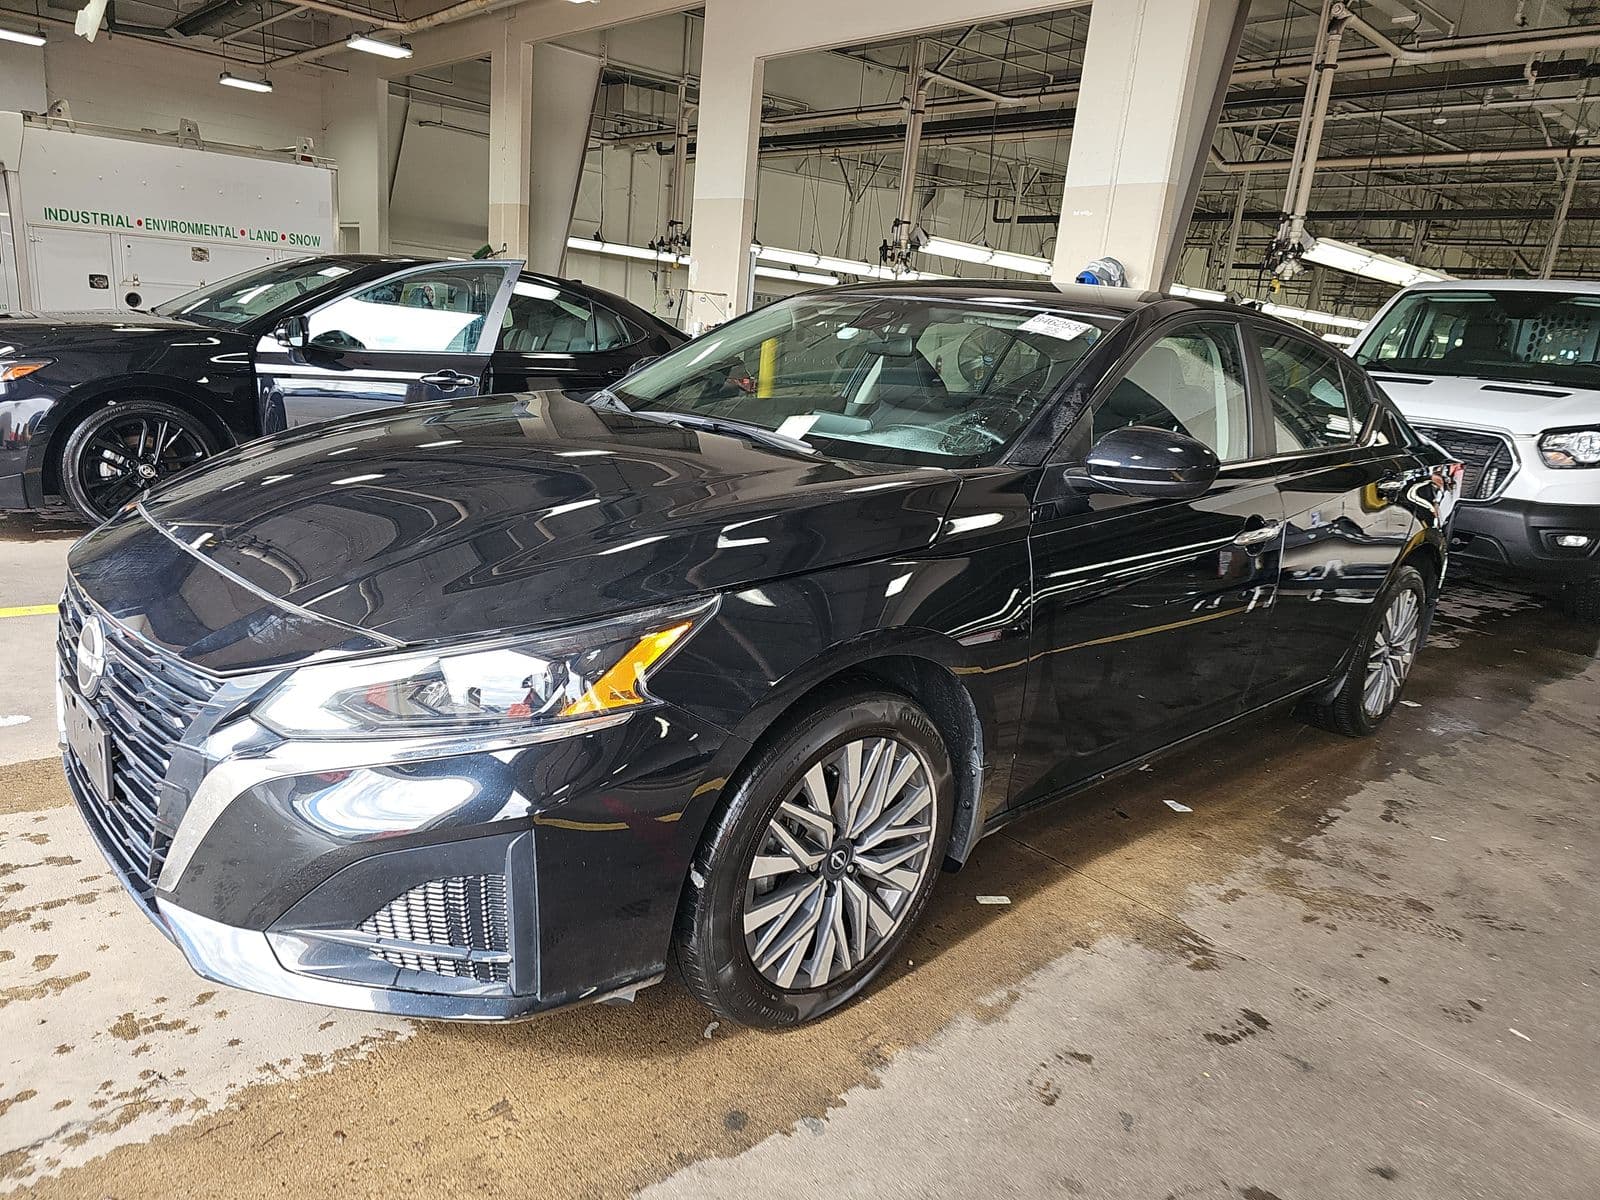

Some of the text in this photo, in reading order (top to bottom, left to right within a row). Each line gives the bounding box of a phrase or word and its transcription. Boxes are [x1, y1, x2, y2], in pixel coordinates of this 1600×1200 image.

[44, 207, 321, 247] INDUSTRIAL ENVIRONMENTAL LAND SNOW
